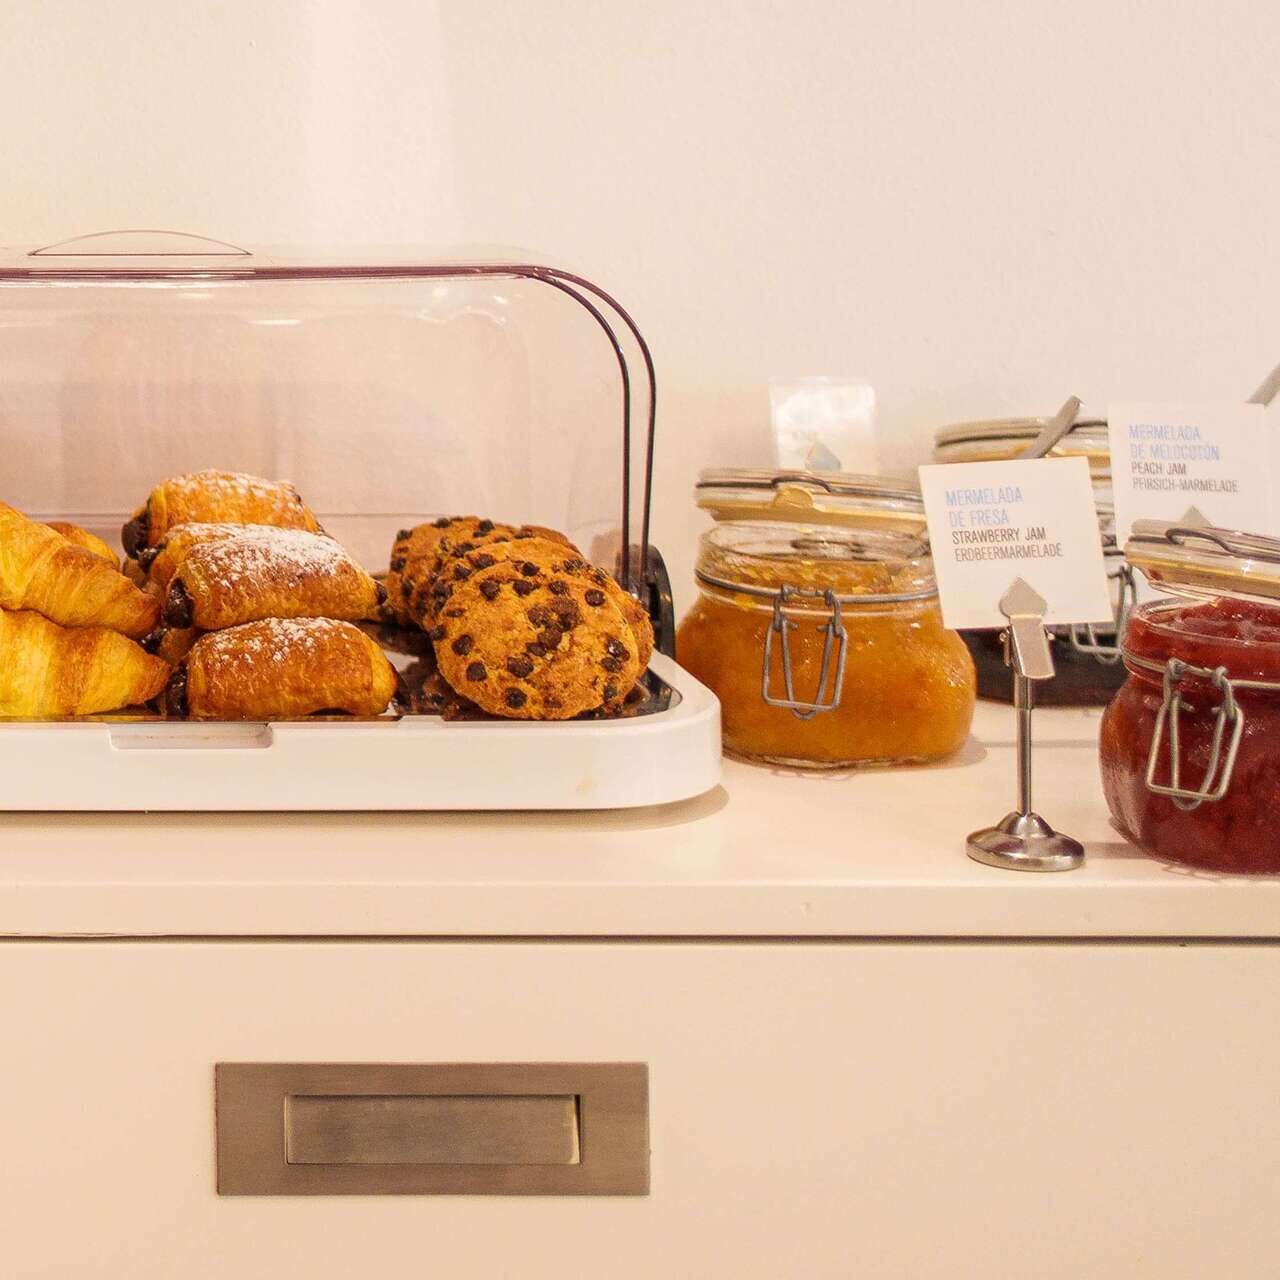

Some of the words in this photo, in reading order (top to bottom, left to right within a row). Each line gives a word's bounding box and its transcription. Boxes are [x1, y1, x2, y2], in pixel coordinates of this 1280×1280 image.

[1128, 424, 1201, 441] MERMELADA
[1130, 443, 1145, 460] DE
[1131, 462, 1163, 475] PEACH
[1166, 462, 1187, 475] JAM
[945, 487, 1024, 507] MERMELADA
[949, 510, 966, 528] DE
[969, 508, 1010, 527] FRESA
[951, 528, 1021, 544] STRAWBERRY
[1025, 527, 1047, 541] JAM
[954, 542, 1064, 562] ERDBEERMARMELADE
